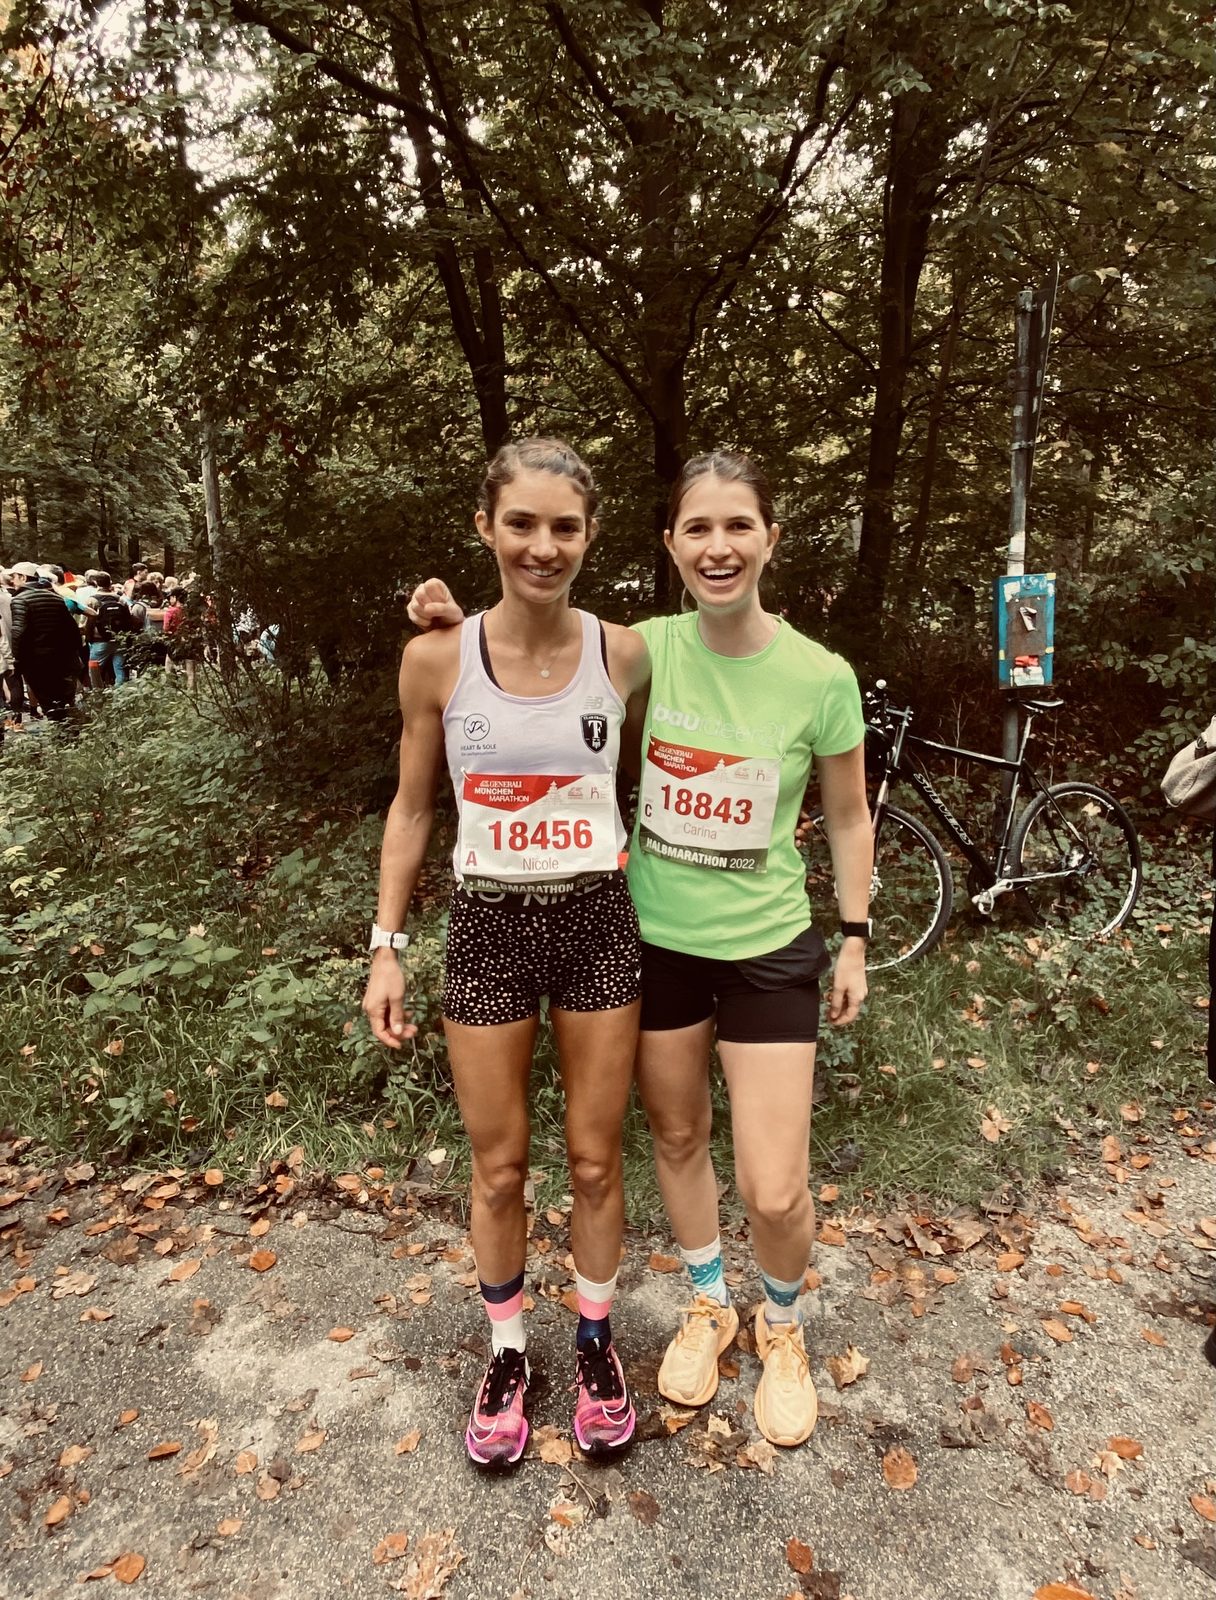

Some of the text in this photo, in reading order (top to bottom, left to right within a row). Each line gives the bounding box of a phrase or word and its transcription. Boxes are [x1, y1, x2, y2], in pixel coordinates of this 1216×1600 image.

[665, 747, 693, 759] GENERALI
[663, 760, 698, 773] MARATHON
[474, 786, 514, 795] MÜNCHEN
[489, 780, 522, 788] GENERALI
[644, 803, 653, 818] C
[661, 784, 753, 826] 18843
[913, 773, 974, 846] STEVENS
[488, 819, 593, 851] 18456
[683, 822, 718, 840] Carina
[465, 850, 478, 866] A
[646, 837, 755, 870] HALBMARATHON 2022
[522, 857, 560, 871] Nicole
[477, 878, 574, 894] HALBMARATHON
